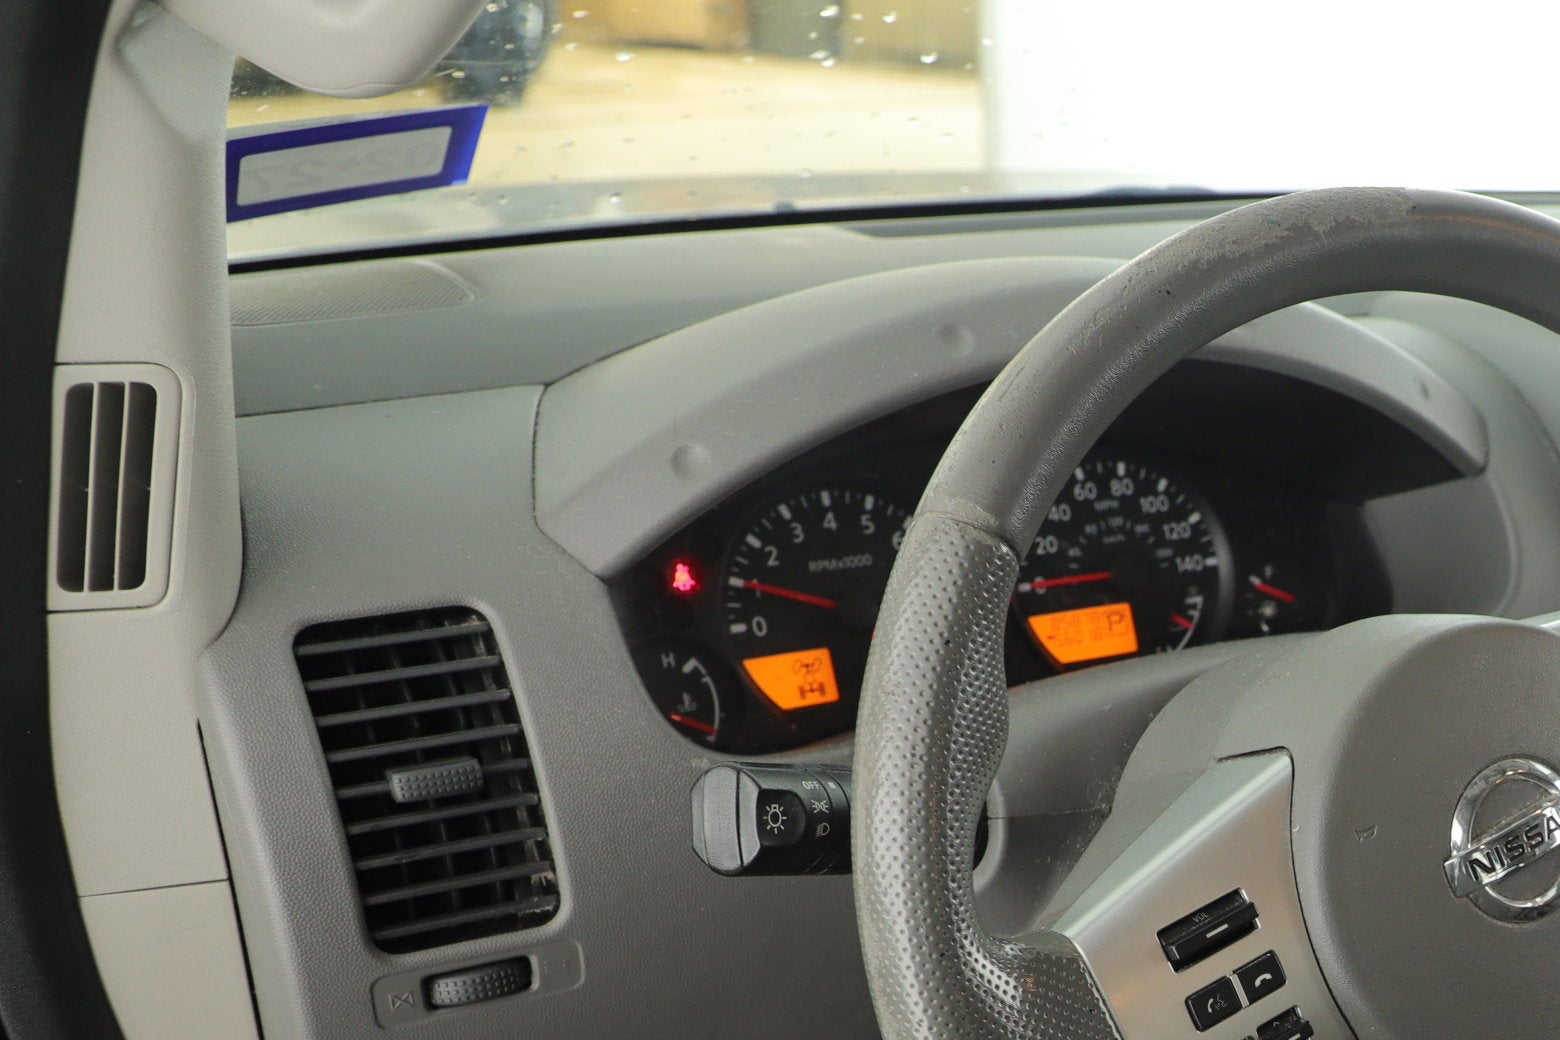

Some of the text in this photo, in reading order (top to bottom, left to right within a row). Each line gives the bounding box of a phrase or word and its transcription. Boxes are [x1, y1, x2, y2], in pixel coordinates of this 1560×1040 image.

[1073, 481, 1098, 501] 60
[1109, 477, 1134, 497] 80
[1138, 494, 1170, 514] 100
[822, 511, 838, 531] 4
[860, 513, 876, 535] 5
[1162, 520, 1192, 541] 120
[789, 521, 805, 544] 3
[1034, 534, 1059, 556] 20
[763, 545, 781, 567] 2
[1174, 553, 1205, 575] 140
[752, 615, 768, 637] 0
[1106, 610, 1125, 632] P
[660, 651, 677, 669] H
[802, 779, 820, 791] OFF
[1192, 911, 1209, 923] VOL
